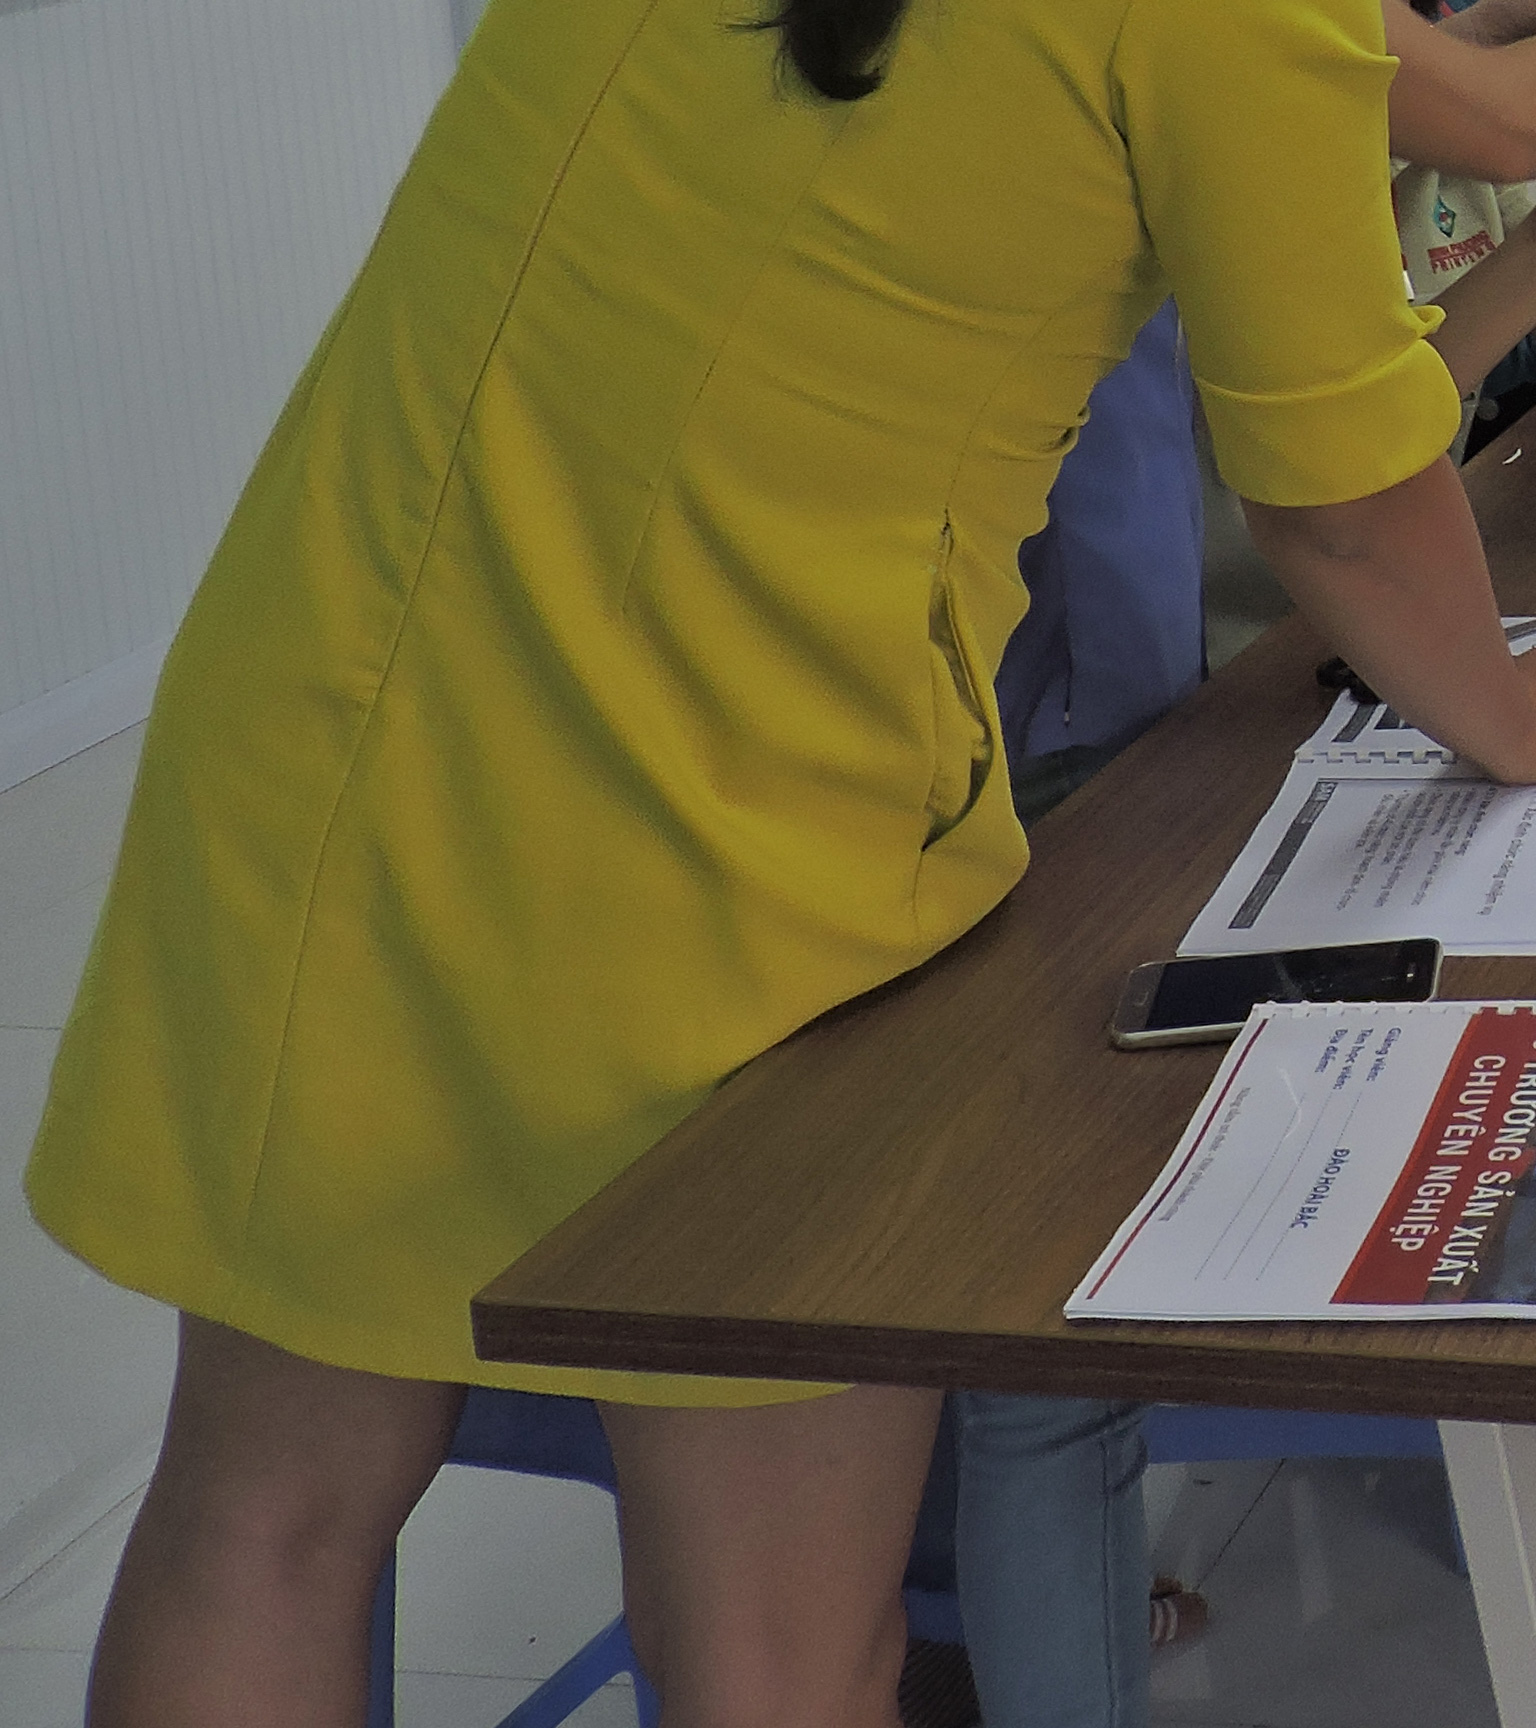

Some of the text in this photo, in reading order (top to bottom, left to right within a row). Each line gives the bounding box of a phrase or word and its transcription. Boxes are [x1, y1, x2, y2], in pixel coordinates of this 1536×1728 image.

[1390, 1055, 1506, 1251] CHUYÊN NGHIỆP
[1461, 1170, 1516, 1217] SẢN
[1427, 1225, 1487, 1286] XUẤT
